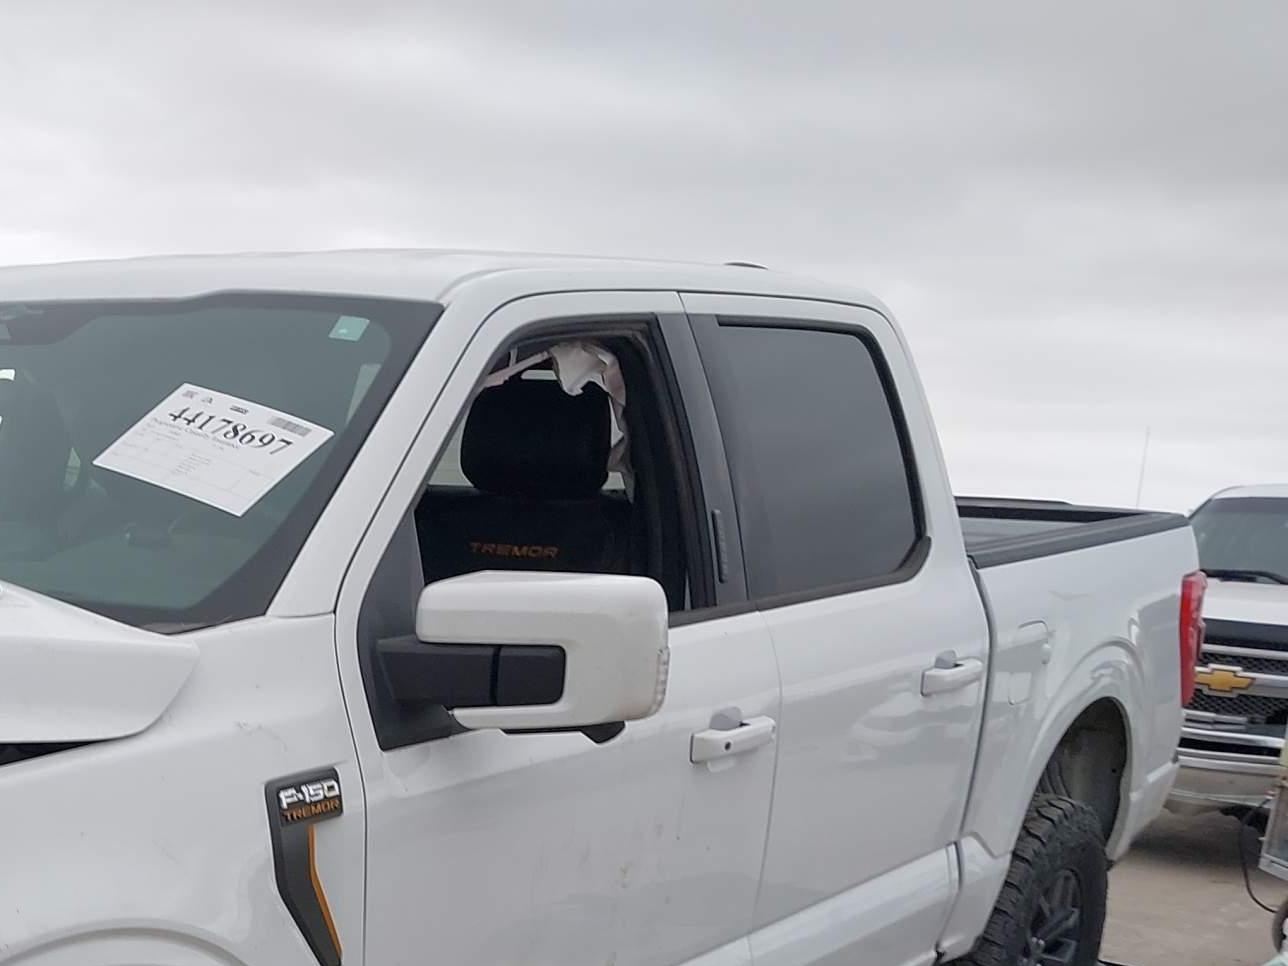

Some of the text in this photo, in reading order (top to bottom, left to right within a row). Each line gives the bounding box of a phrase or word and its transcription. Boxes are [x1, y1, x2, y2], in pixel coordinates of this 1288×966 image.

[168, 406, 294, 455] 44178697
[470, 542, 559, 558] TREMOR
[279, 780, 340, 809] F-150
[281, 800, 340, 821] TREMOR
